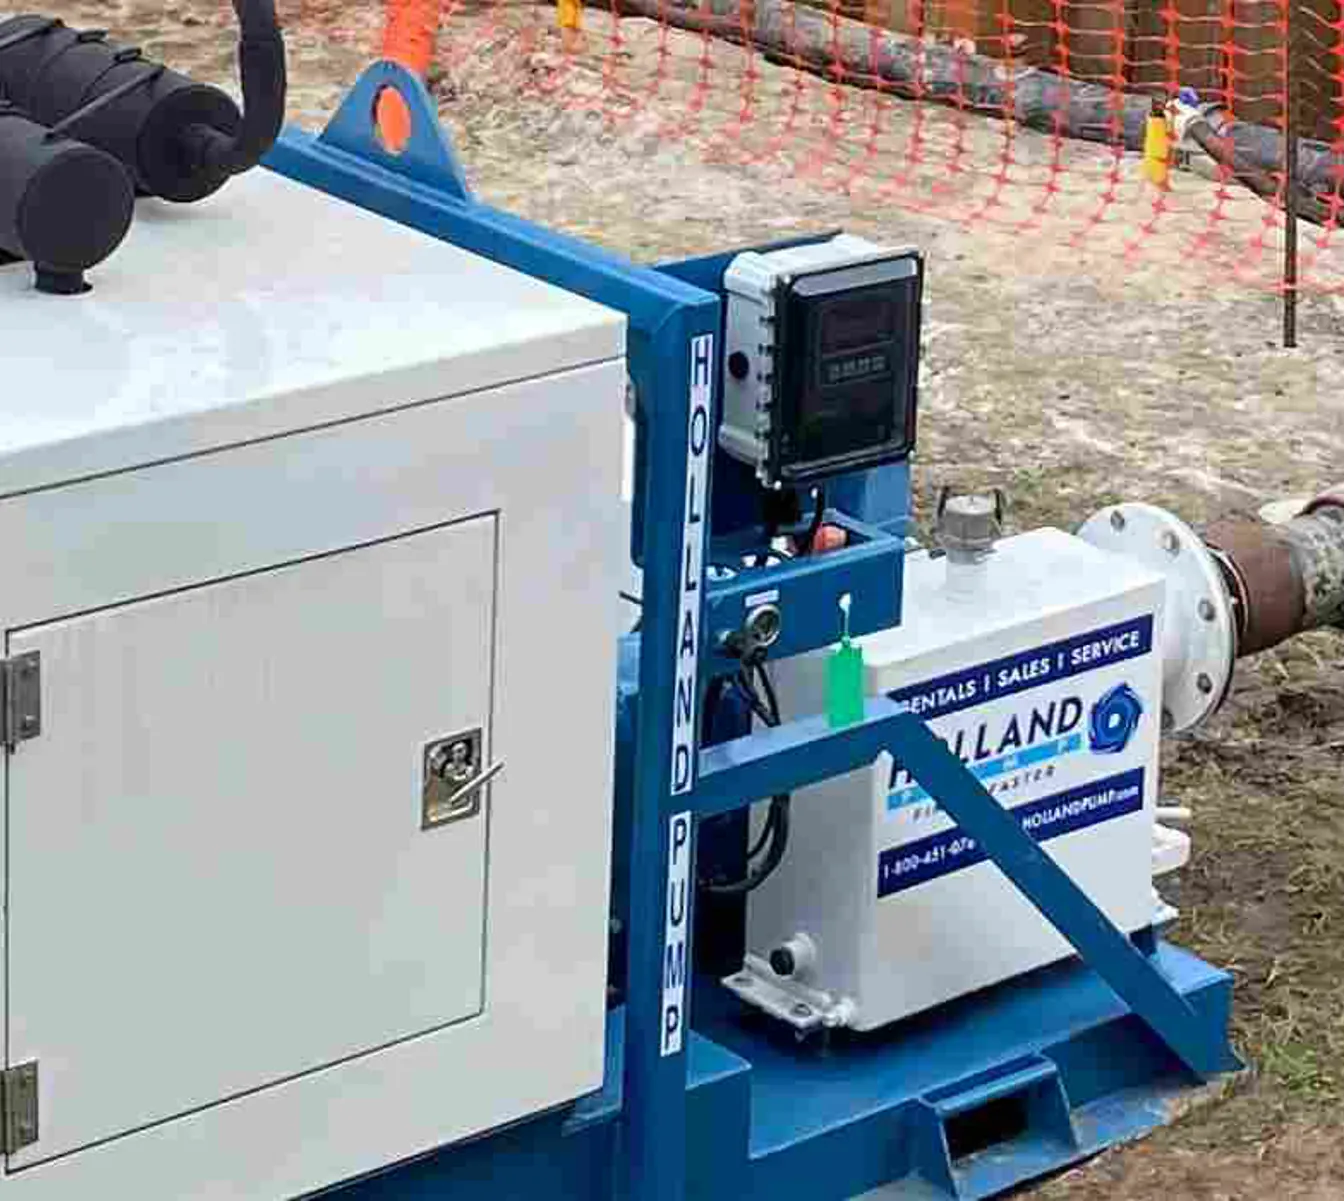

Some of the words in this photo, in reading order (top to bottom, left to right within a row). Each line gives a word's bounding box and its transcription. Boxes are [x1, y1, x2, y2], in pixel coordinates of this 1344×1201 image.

[674, 337, 709, 792] HOLLAND
[997, 657, 1051, 688] SALES
[1071, 630, 1140, 665] SERVICE
[888, 697, 1083, 790] HLLAND
[665, 817, 688, 1052] PUMP
